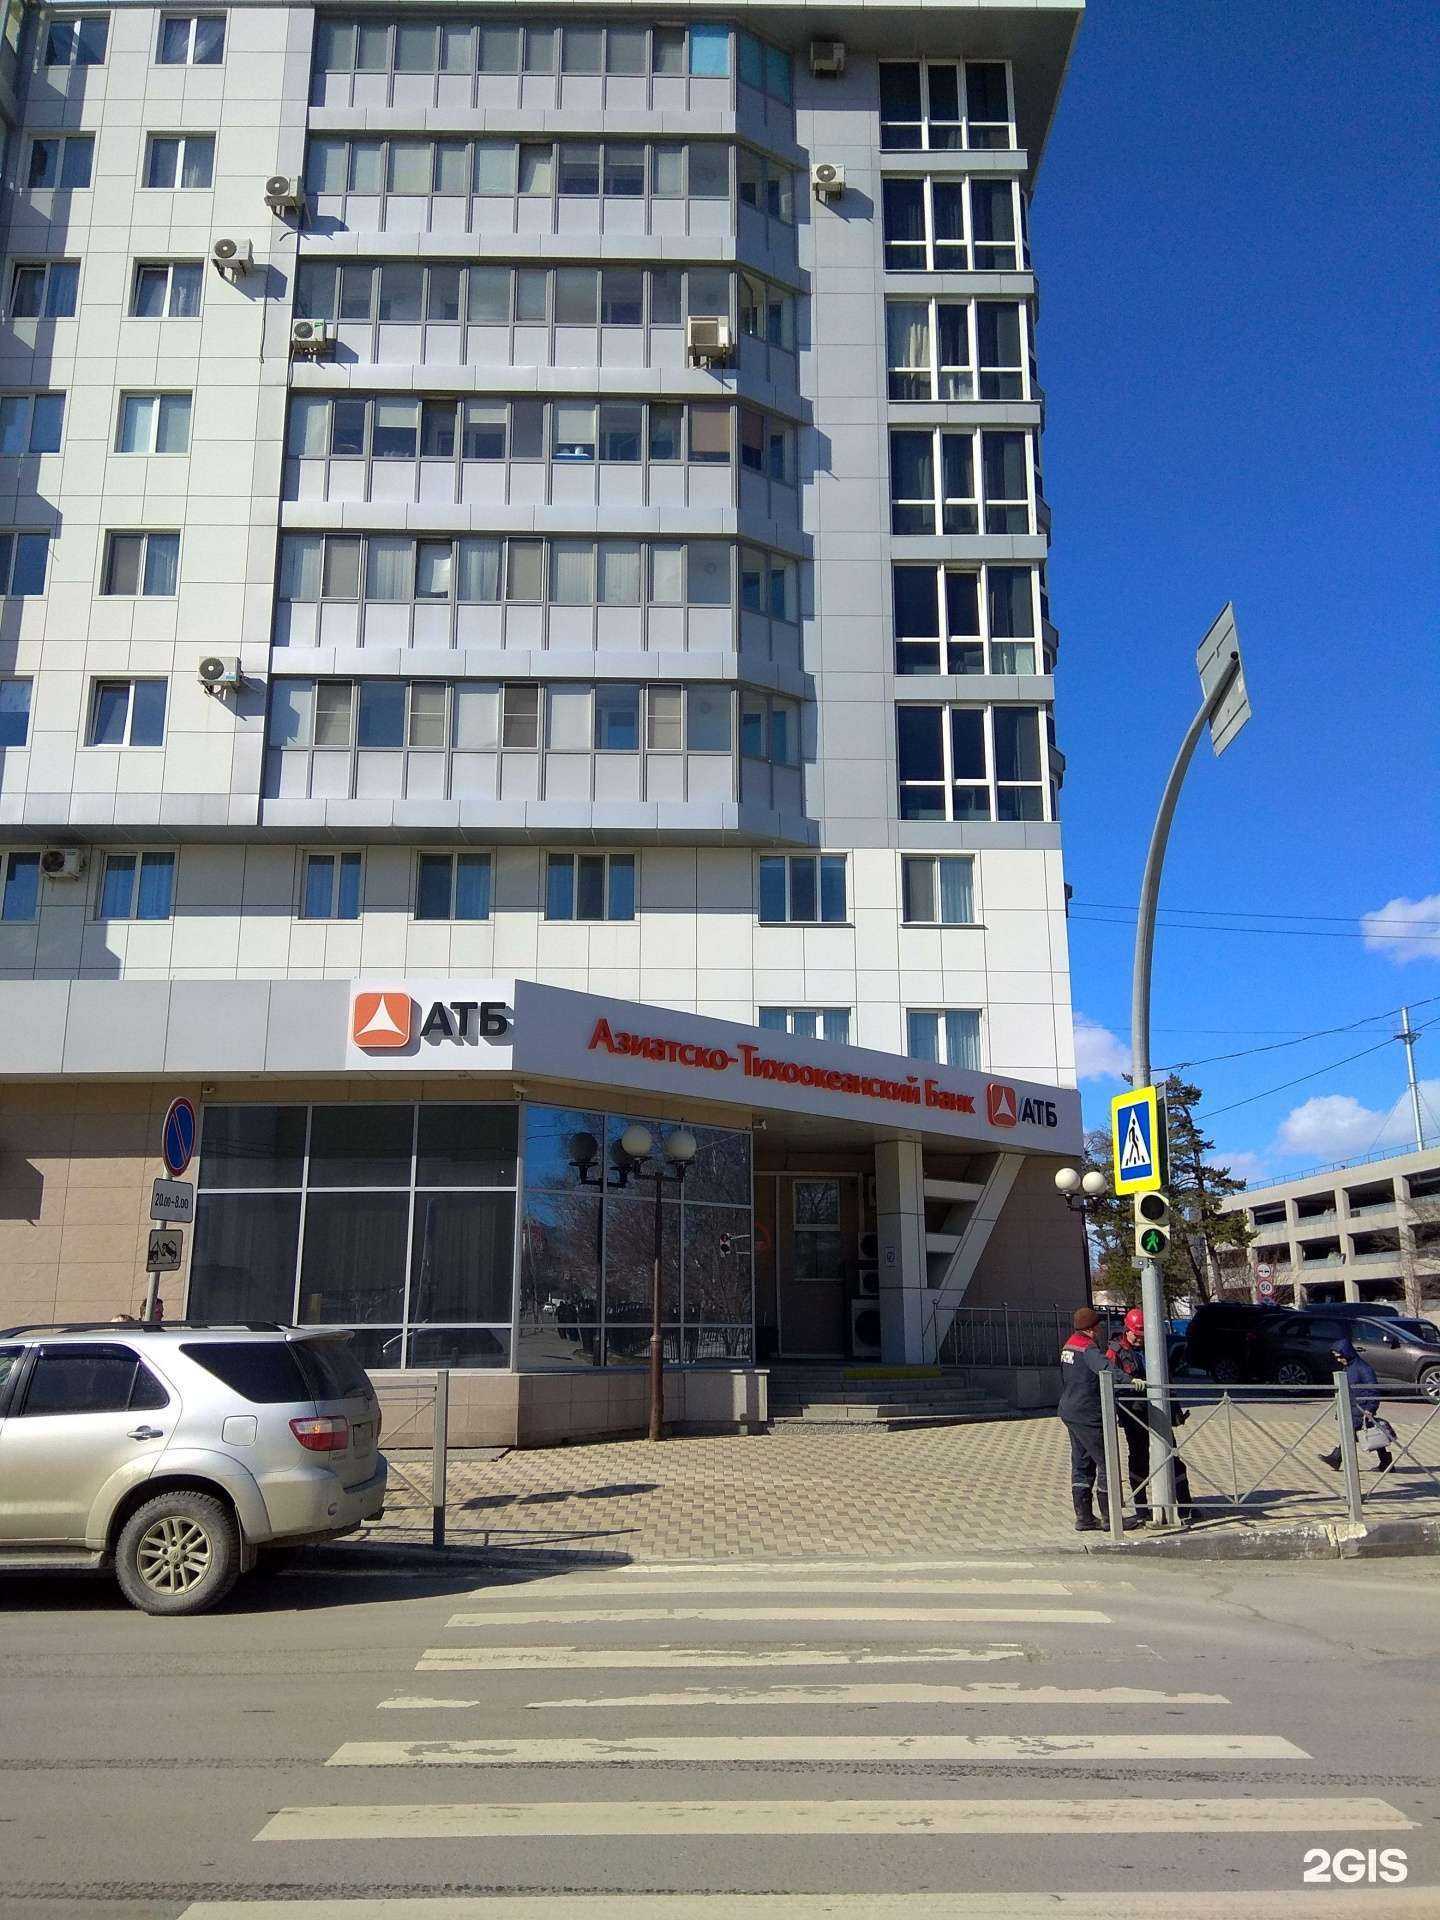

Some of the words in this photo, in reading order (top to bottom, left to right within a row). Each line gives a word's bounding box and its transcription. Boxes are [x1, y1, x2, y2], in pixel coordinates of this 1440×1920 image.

[420, 1002, 507, 1036] АТБ
[588, 1018, 921, 1105] Азиатско-Тихоокеанский
[924, 1079, 976, 1114] Банк
[1021, 1097, 1058, 1127] АТБ
